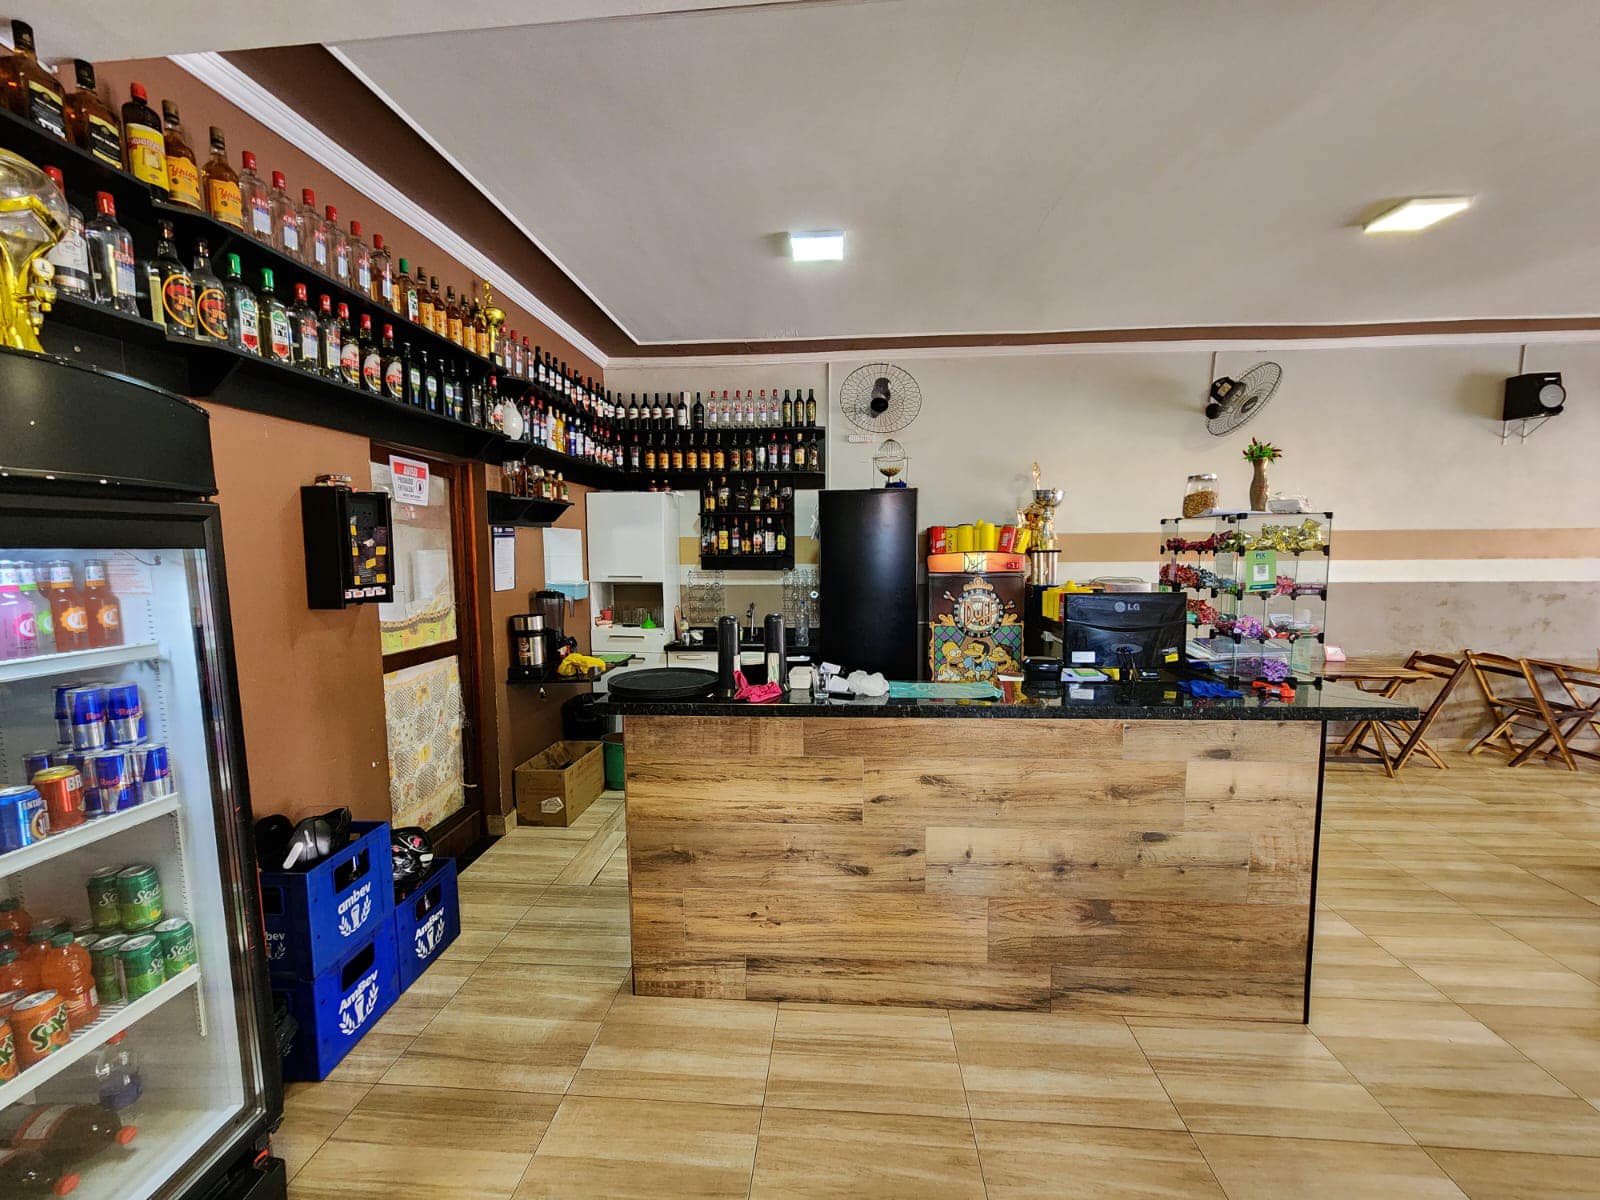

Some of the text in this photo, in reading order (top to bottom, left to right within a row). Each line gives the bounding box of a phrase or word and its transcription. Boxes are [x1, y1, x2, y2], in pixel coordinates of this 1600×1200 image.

[964, 600, 996, 626] Duff
[337, 881, 371, 915] ambev
[415, 907, 445, 941] AmBev
[338, 969, 378, 1015] AmBev
